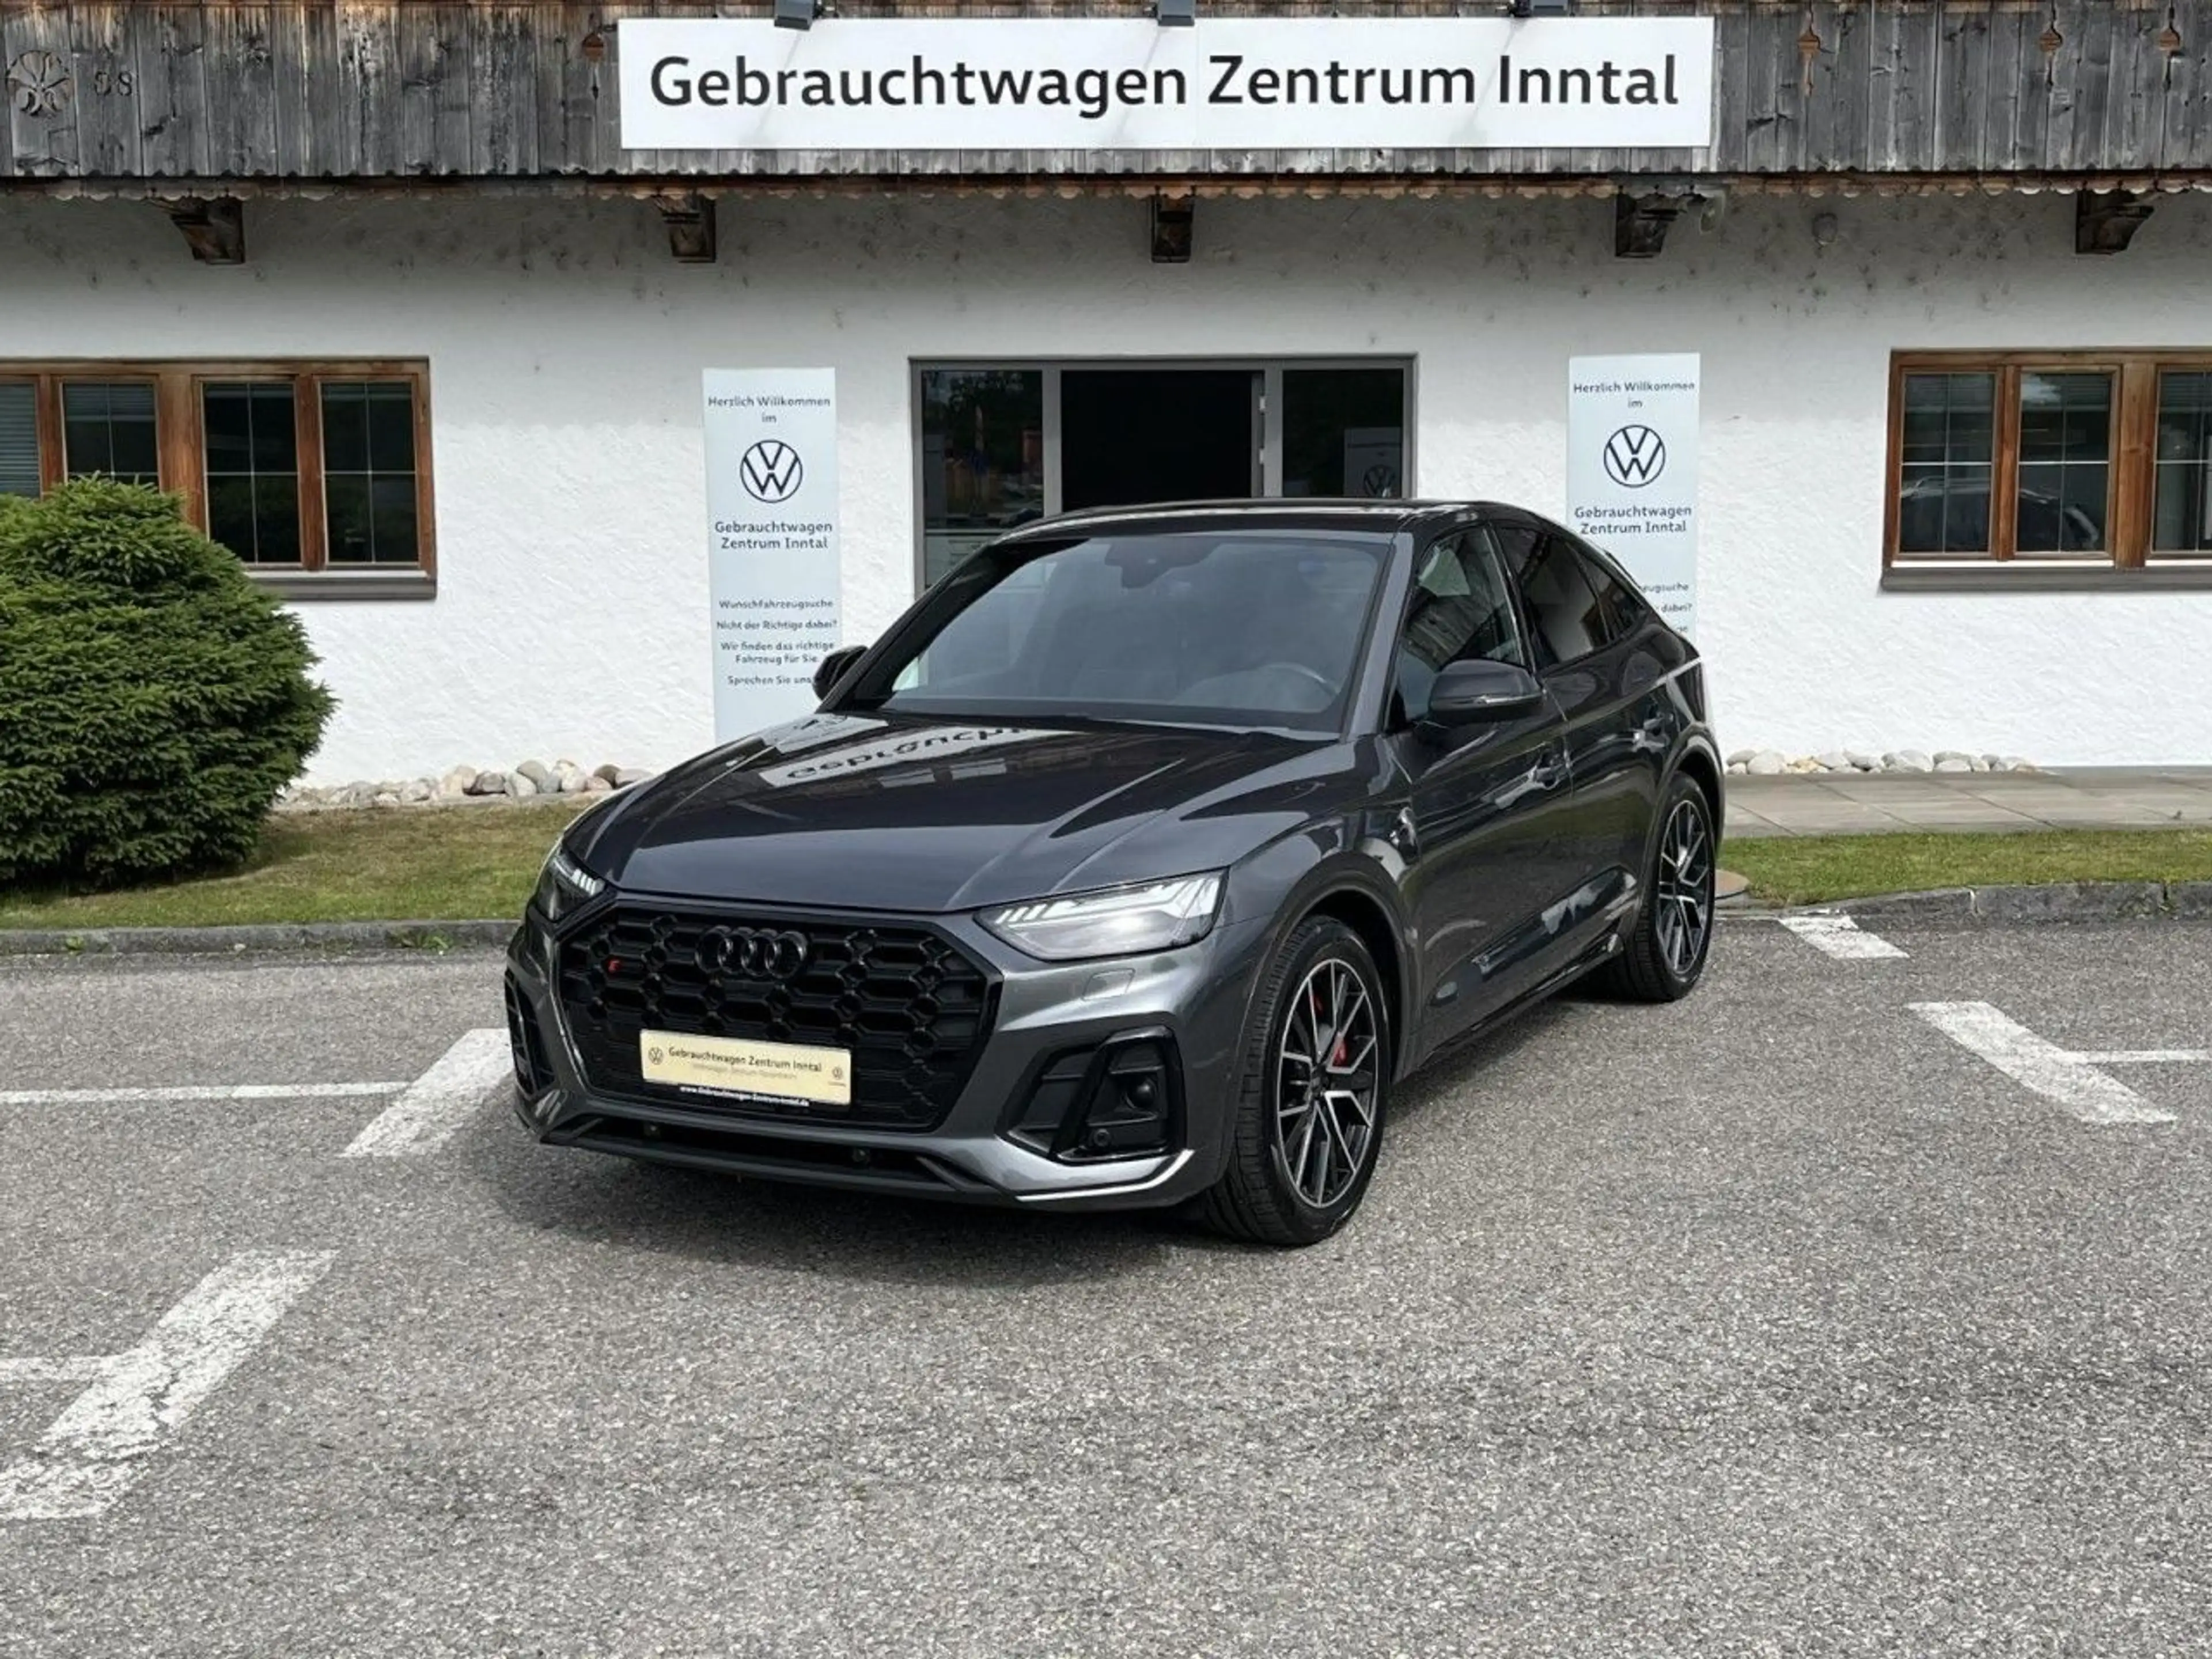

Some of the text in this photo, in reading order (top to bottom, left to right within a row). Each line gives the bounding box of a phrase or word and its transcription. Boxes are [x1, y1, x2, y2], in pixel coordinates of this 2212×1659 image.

[651, 54, 1678, 119] Gebrauchtwagen Zentrum Inntal
[1574, 381, 1695, 393] Herzlich Willkommen
[708, 396, 831, 407] Herzlich Willkommen
[1628, 398, 1642, 408] im
[762, 414, 777, 423] im
[1574, 506, 1692, 518] Gebrauchtwagen
[715, 521, 832, 535] Gebrauchtwagen
[1581, 521, 1687, 535] Zentrum Inntal
[721, 537, 828, 549] Zentrum Inntal
[717, 620, 742, 630] Nicht
[744, 620, 760, 630] der
[762, 620, 803, 631] Richtige
[721, 641, 834, 652] Wir finden das richtige
[736, 654, 782, 666] Fahrzeug
[784, 654, 800, 662] für
[728, 676, 774, 686] Sprechen
[776, 676, 791, 684] Sie
[668, 1046, 746, 1065] Gebrauchtwagen
[748, 1055, 791, 1069] Zentrum
[793, 1060, 821, 1072] Inntal
